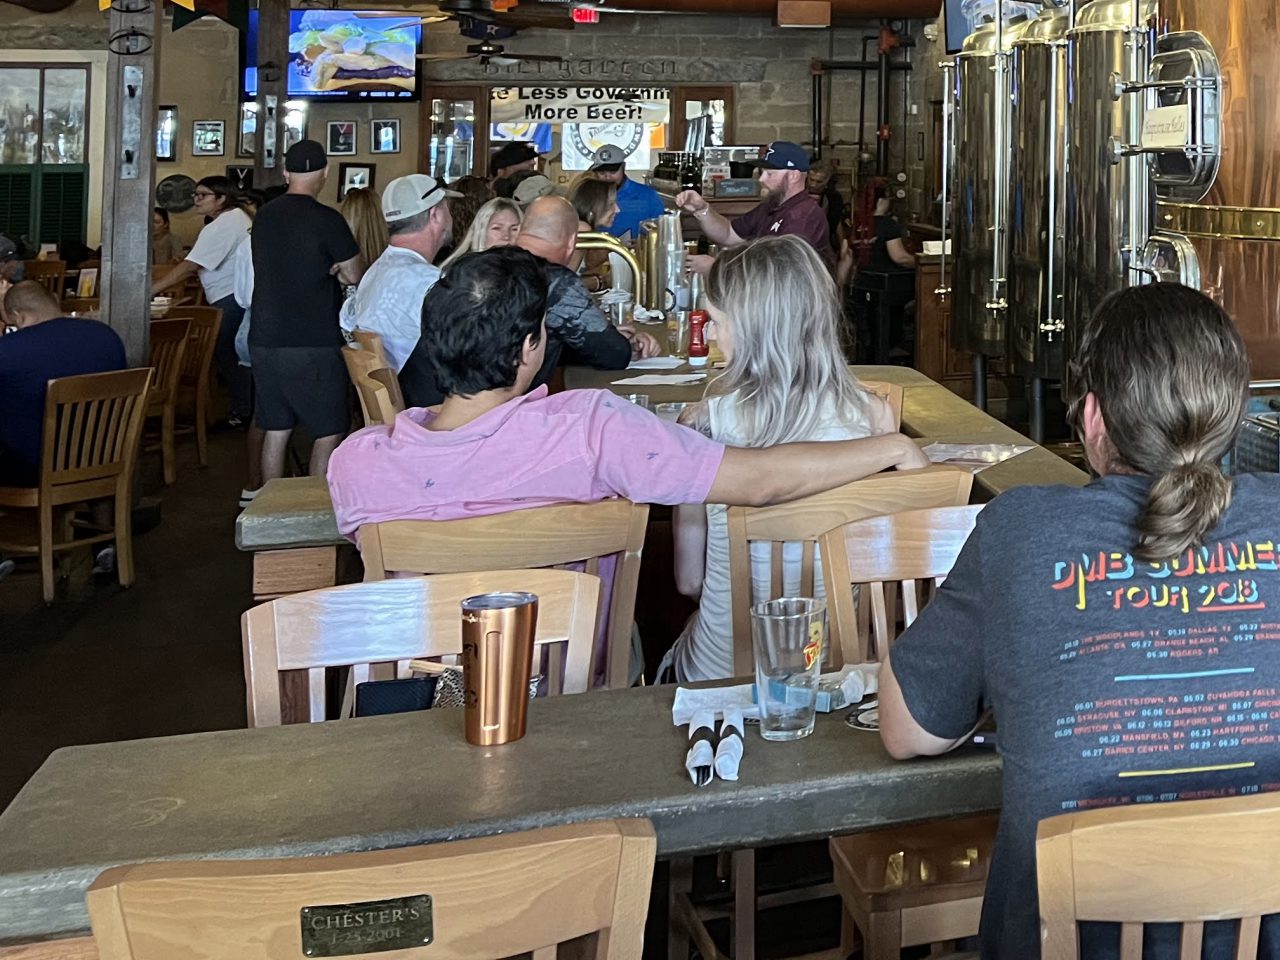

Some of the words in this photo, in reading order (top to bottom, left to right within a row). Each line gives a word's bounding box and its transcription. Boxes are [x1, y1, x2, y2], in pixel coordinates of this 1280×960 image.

[518, 88, 567, 100] Less
[525, 104, 578, 120] More
[587, 104, 643, 120] Beer!
[1051, 551, 1135, 611] DMB
[1106, 583, 1190, 614] TOUR
[1197, 578, 1260, 607] 2018
[311, 906, 420, 930] CHESTER'S
